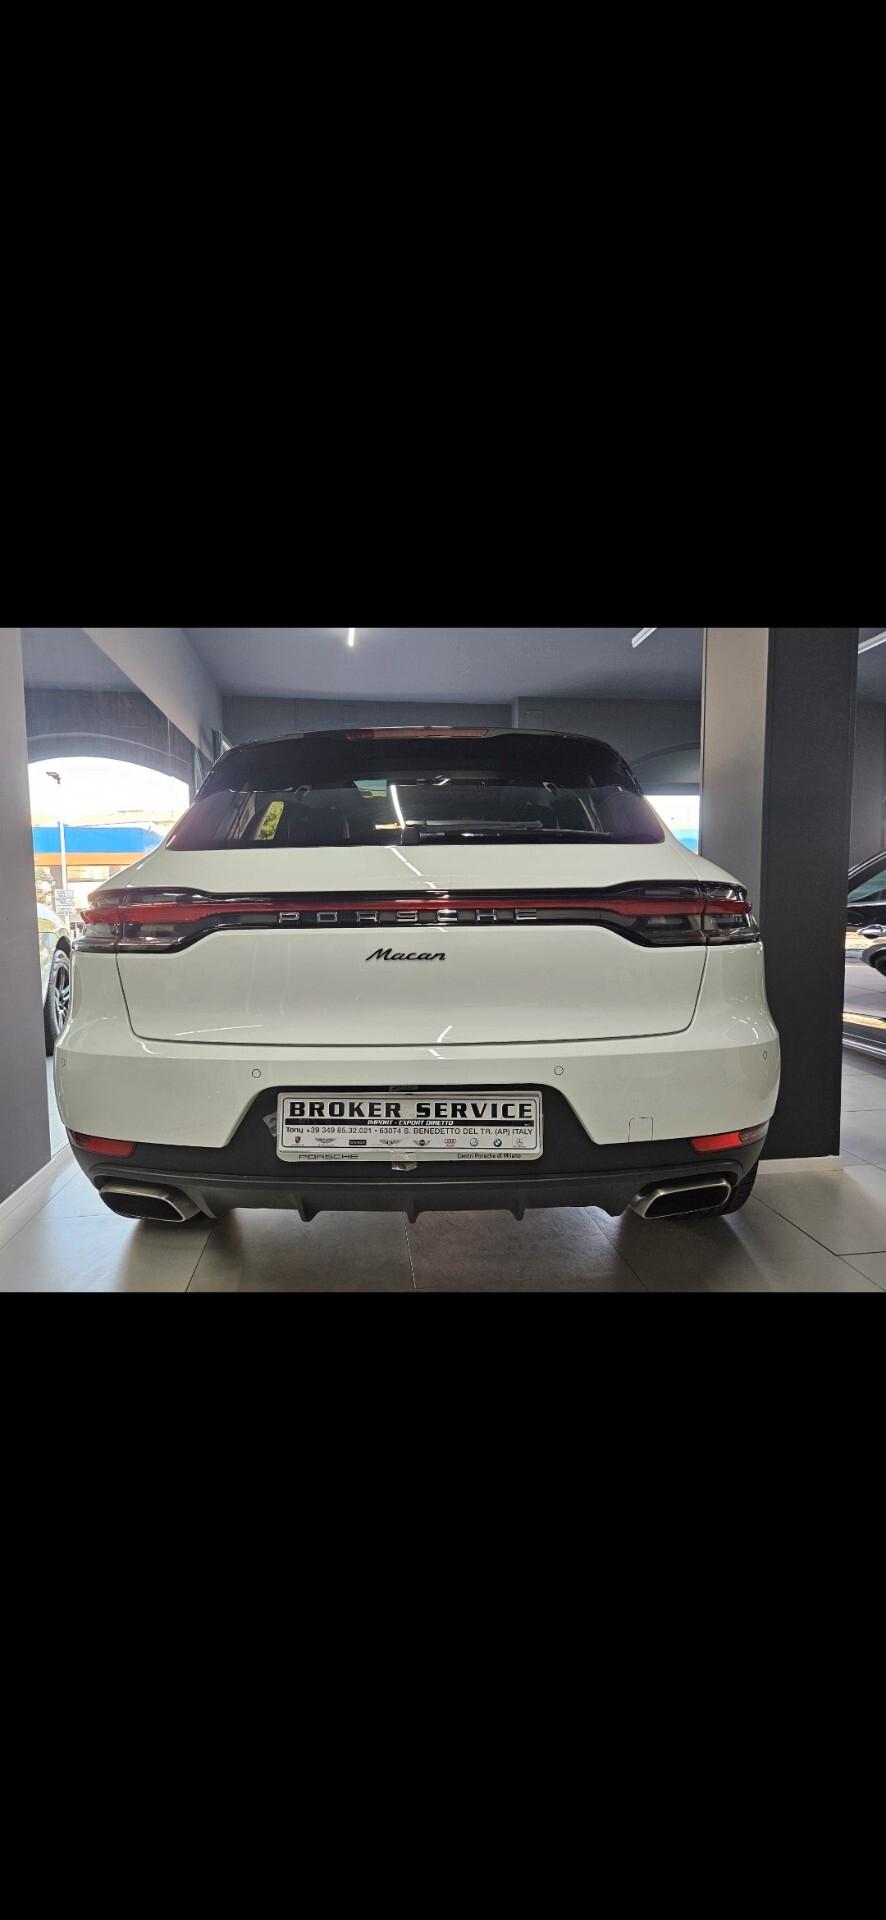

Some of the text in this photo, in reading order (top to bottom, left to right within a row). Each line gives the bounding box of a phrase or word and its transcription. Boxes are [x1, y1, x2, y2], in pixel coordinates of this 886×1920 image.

[278, 909, 537, 923] PORSCHE
[365, 947, 447, 961] Macan
[289, 1101, 532, 1119] BROKER SERVICE
[286, 1126, 304, 1134] Tony
[403, 1127, 411, 1135] S.
[413, 1127, 460, 1135] BENEDETTO
[495, 1128, 510, 1136] (AP)
